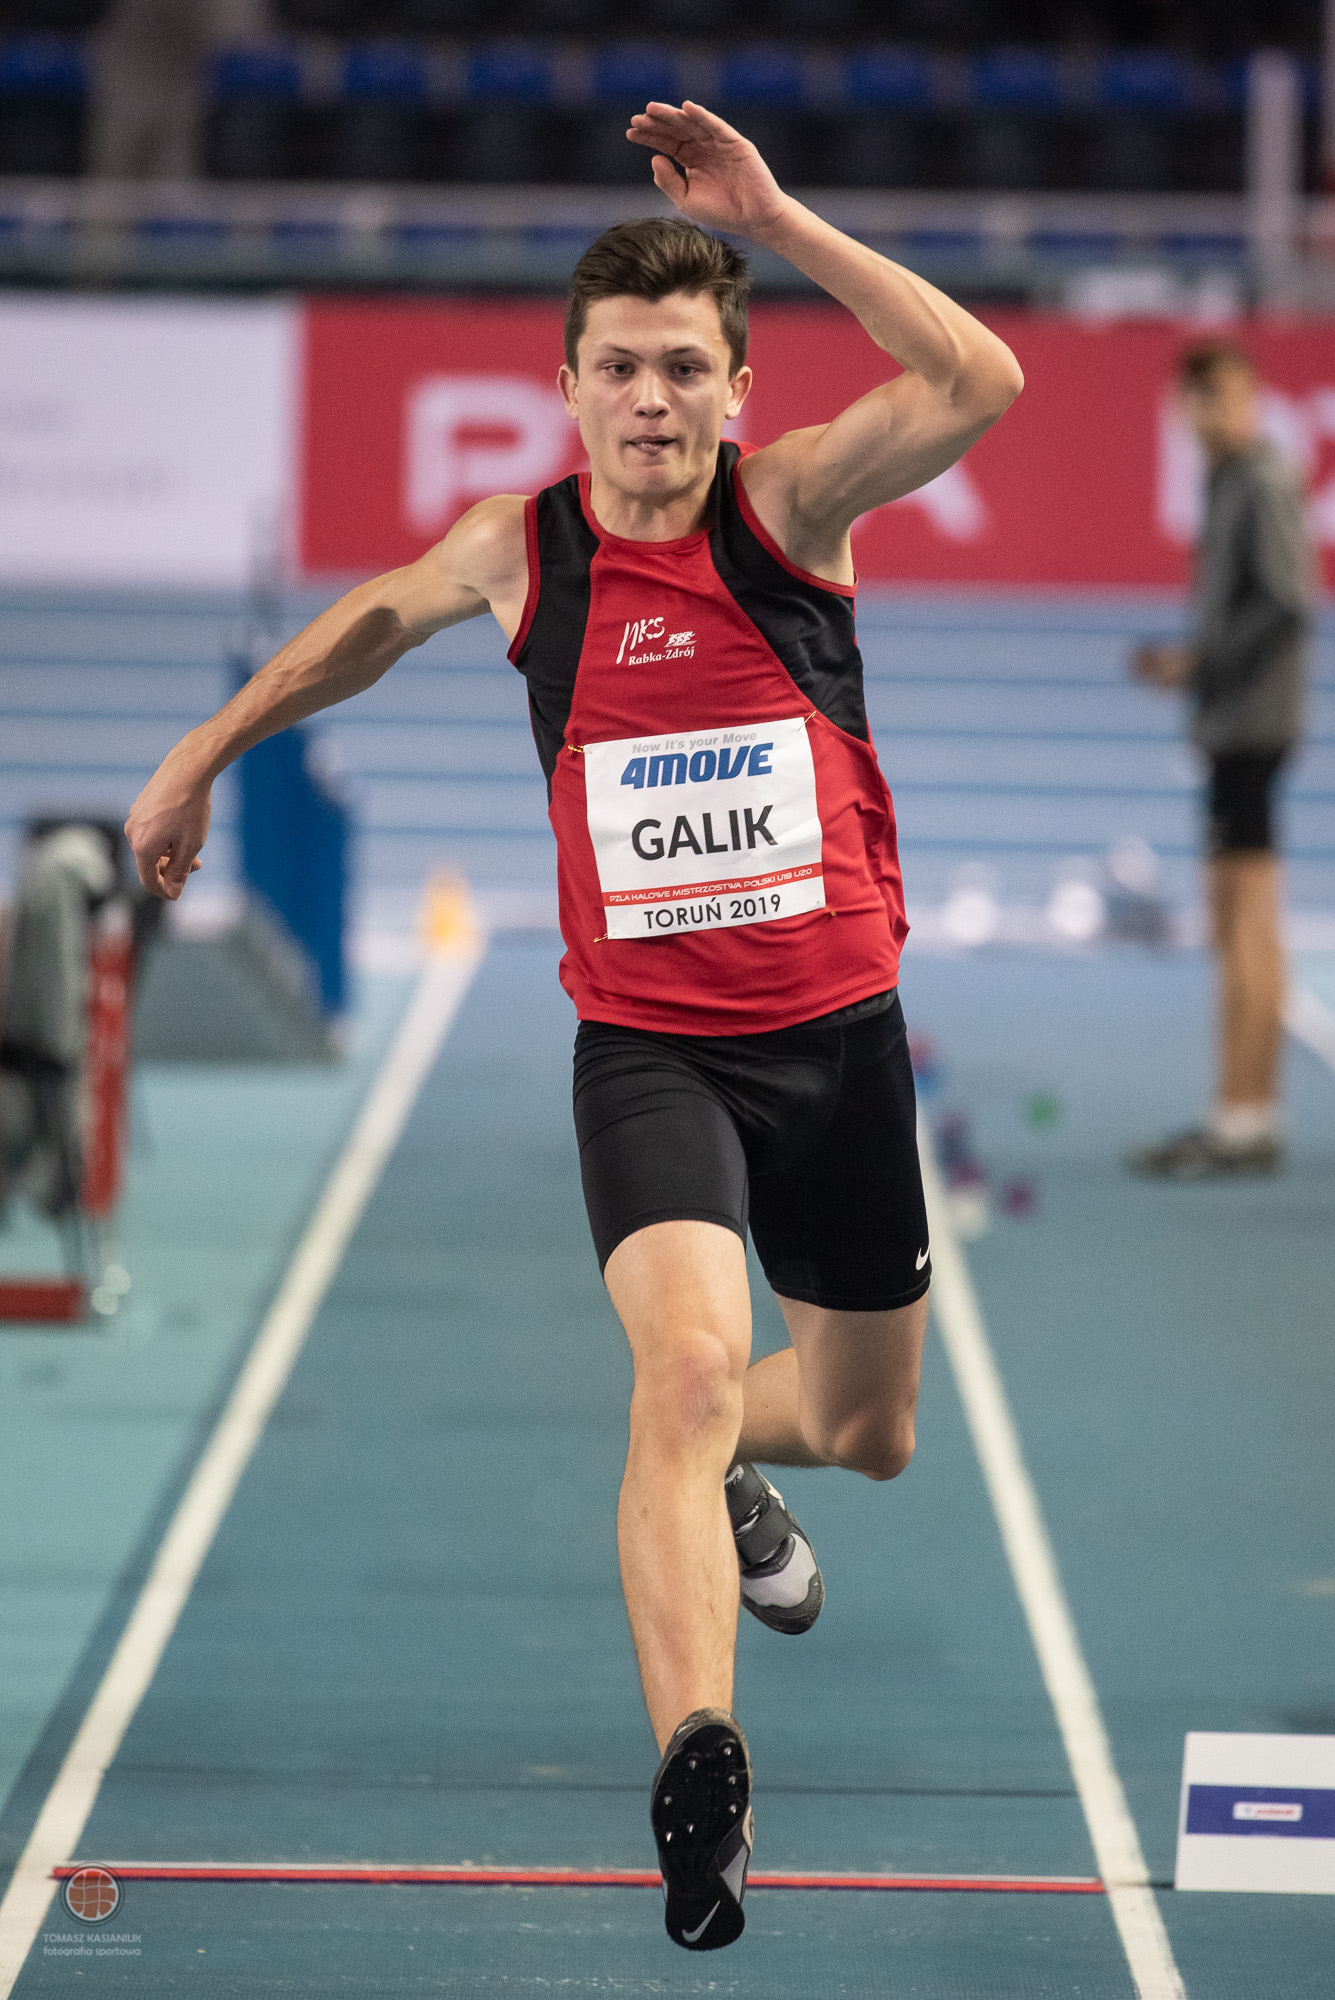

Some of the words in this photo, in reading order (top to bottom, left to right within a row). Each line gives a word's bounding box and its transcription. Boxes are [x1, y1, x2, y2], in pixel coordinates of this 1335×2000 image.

[628, 646, 695, 666] Rabka-Zdrój
[632, 743, 661, 754] Now
[665, 738, 685, 750] It's
[689, 736, 719, 750] your
[722, 731, 757, 744] Move
[620, 742, 774, 790] 4MOVE
[631, 804, 779, 862] GALIK
[609, 893, 630, 903] PZLA
[632, 889, 671, 901] HALOWE
[672, 881, 743, 898] MISTRZOSTWA
[743, 876, 776, 889] POLSKI
[777, 872, 793, 882] U18
[794, 868, 813, 879] U20
[644, 897, 722, 929] TORUŃ
[729, 893, 782, 920] 2019
